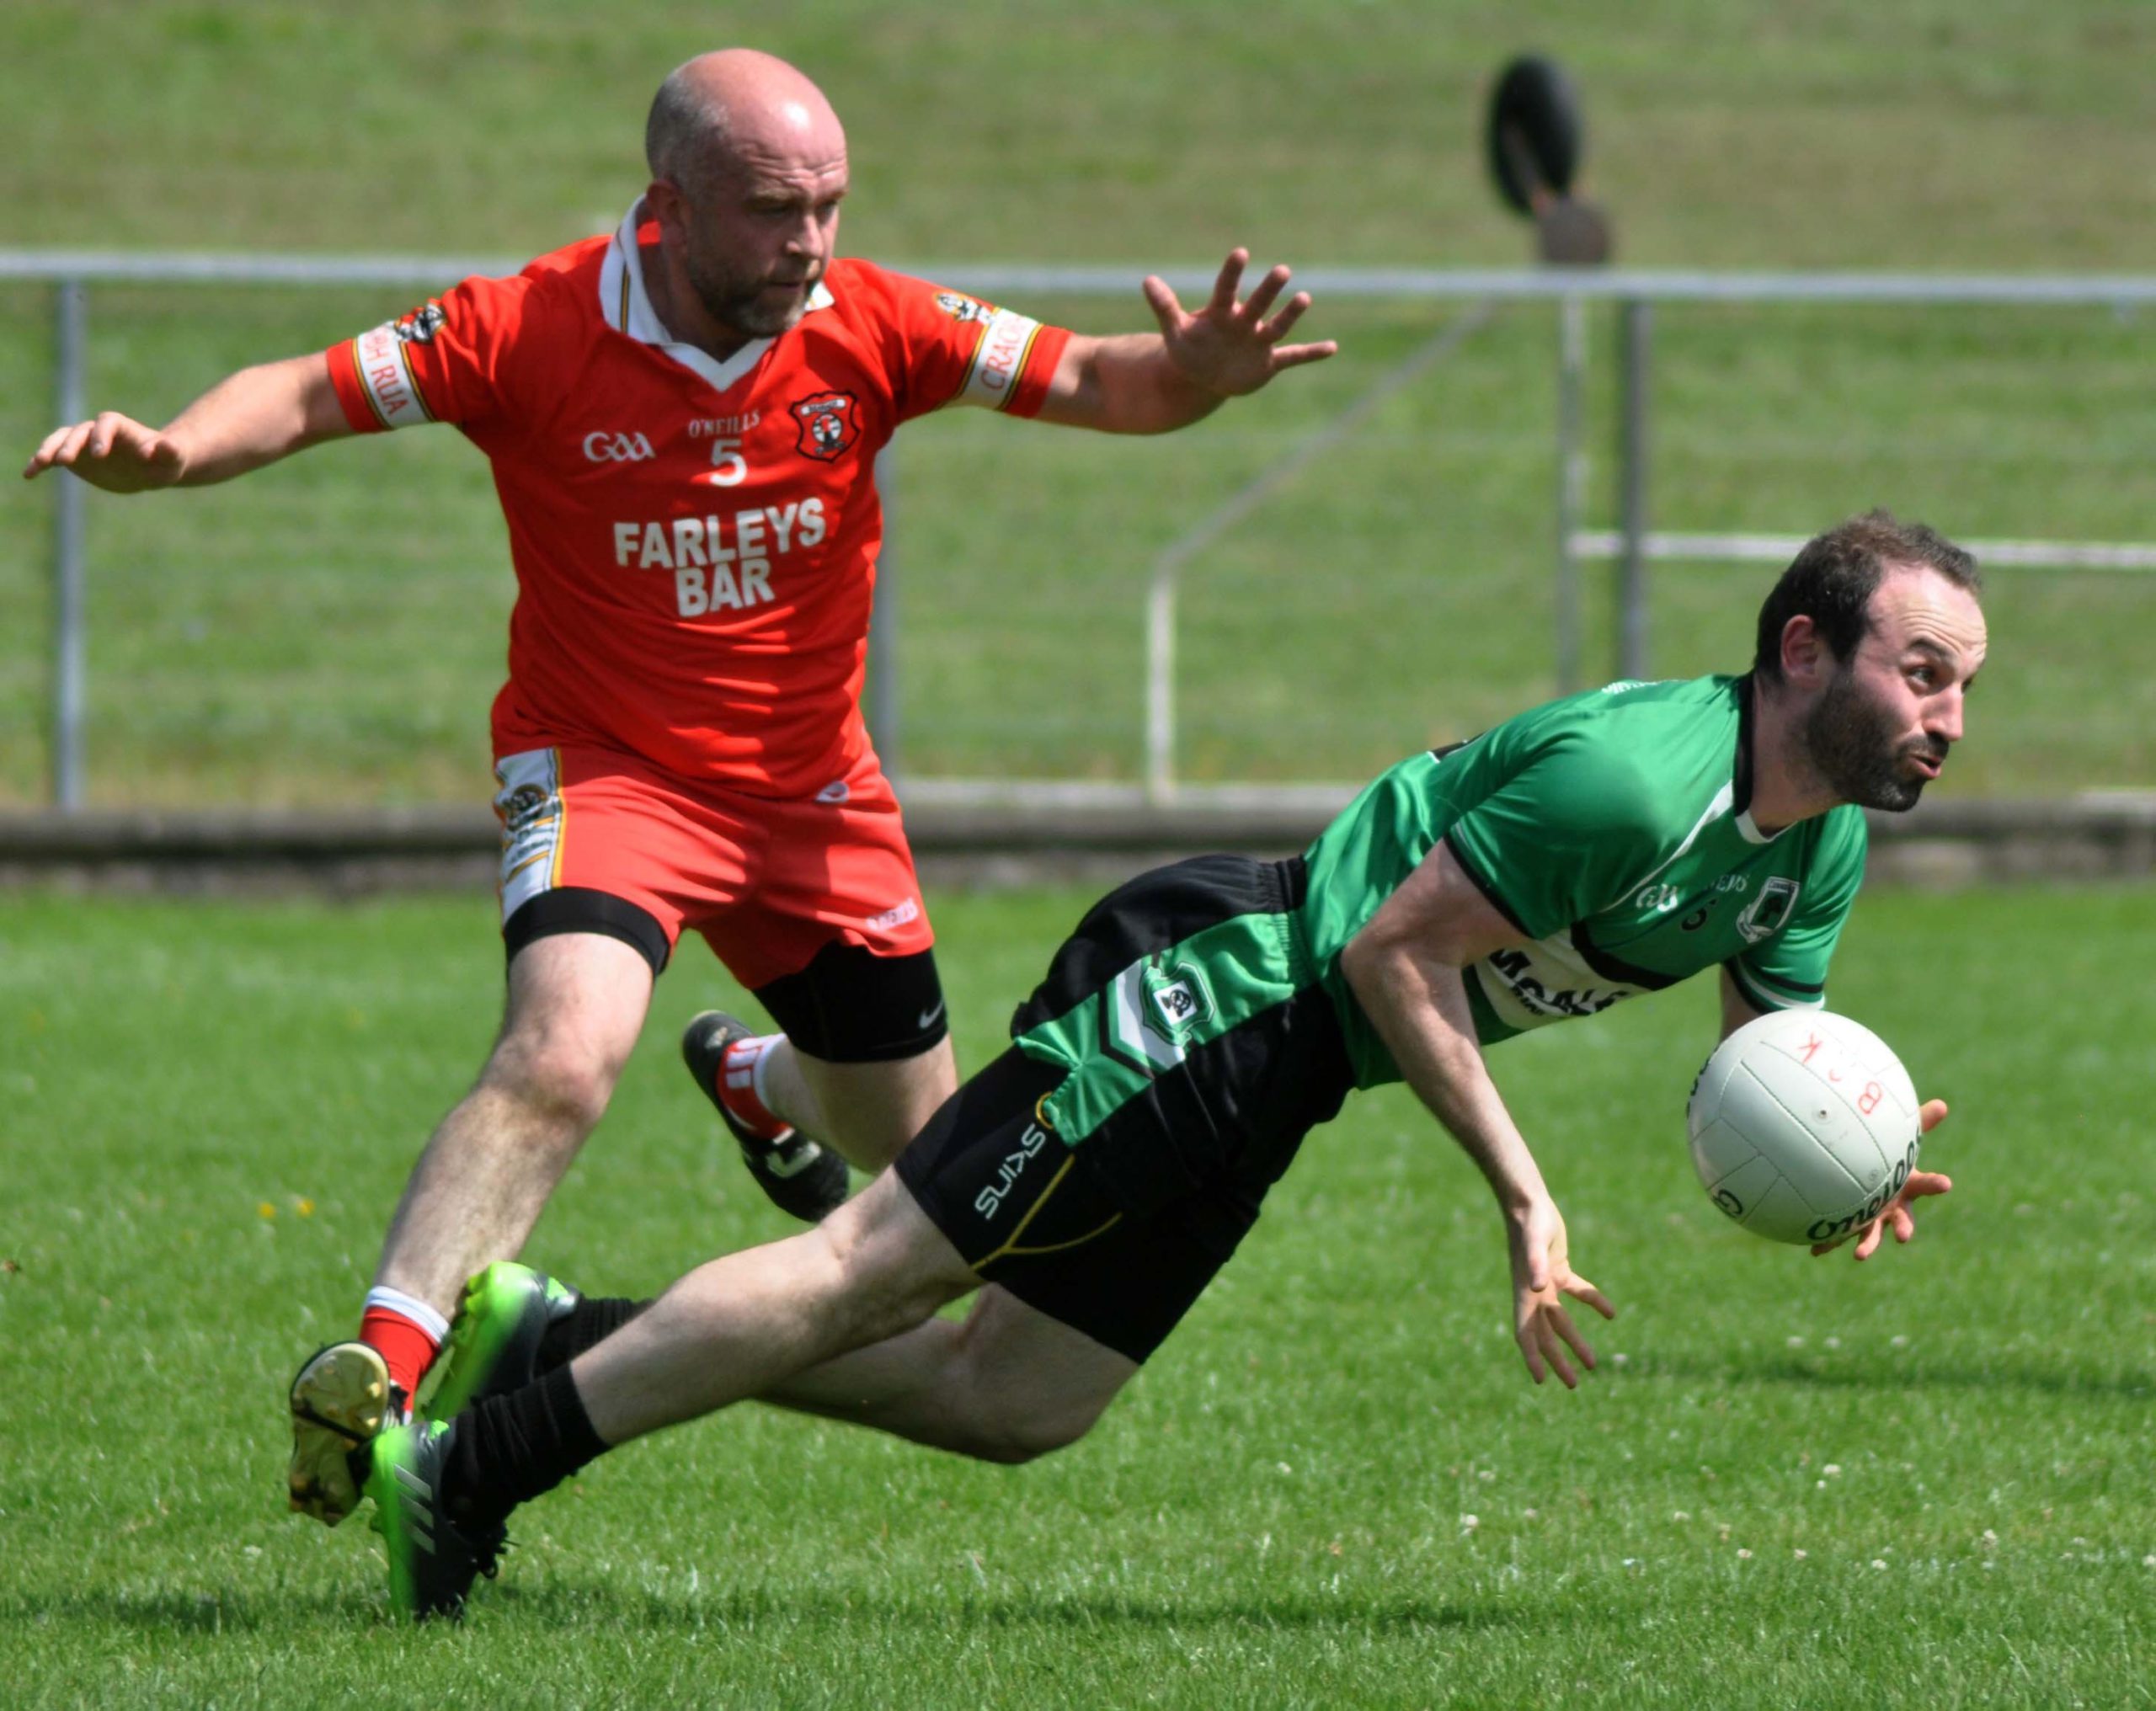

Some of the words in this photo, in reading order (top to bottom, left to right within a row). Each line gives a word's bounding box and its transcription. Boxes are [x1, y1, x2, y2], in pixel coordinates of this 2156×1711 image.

[371, 365, 410, 416] RUA
[710, 439, 748, 487] 5
[613, 497, 826, 569] FARLEYS
[675, 557, 776, 617] BAR
[974, 1122, 1047, 1220] SKINS
